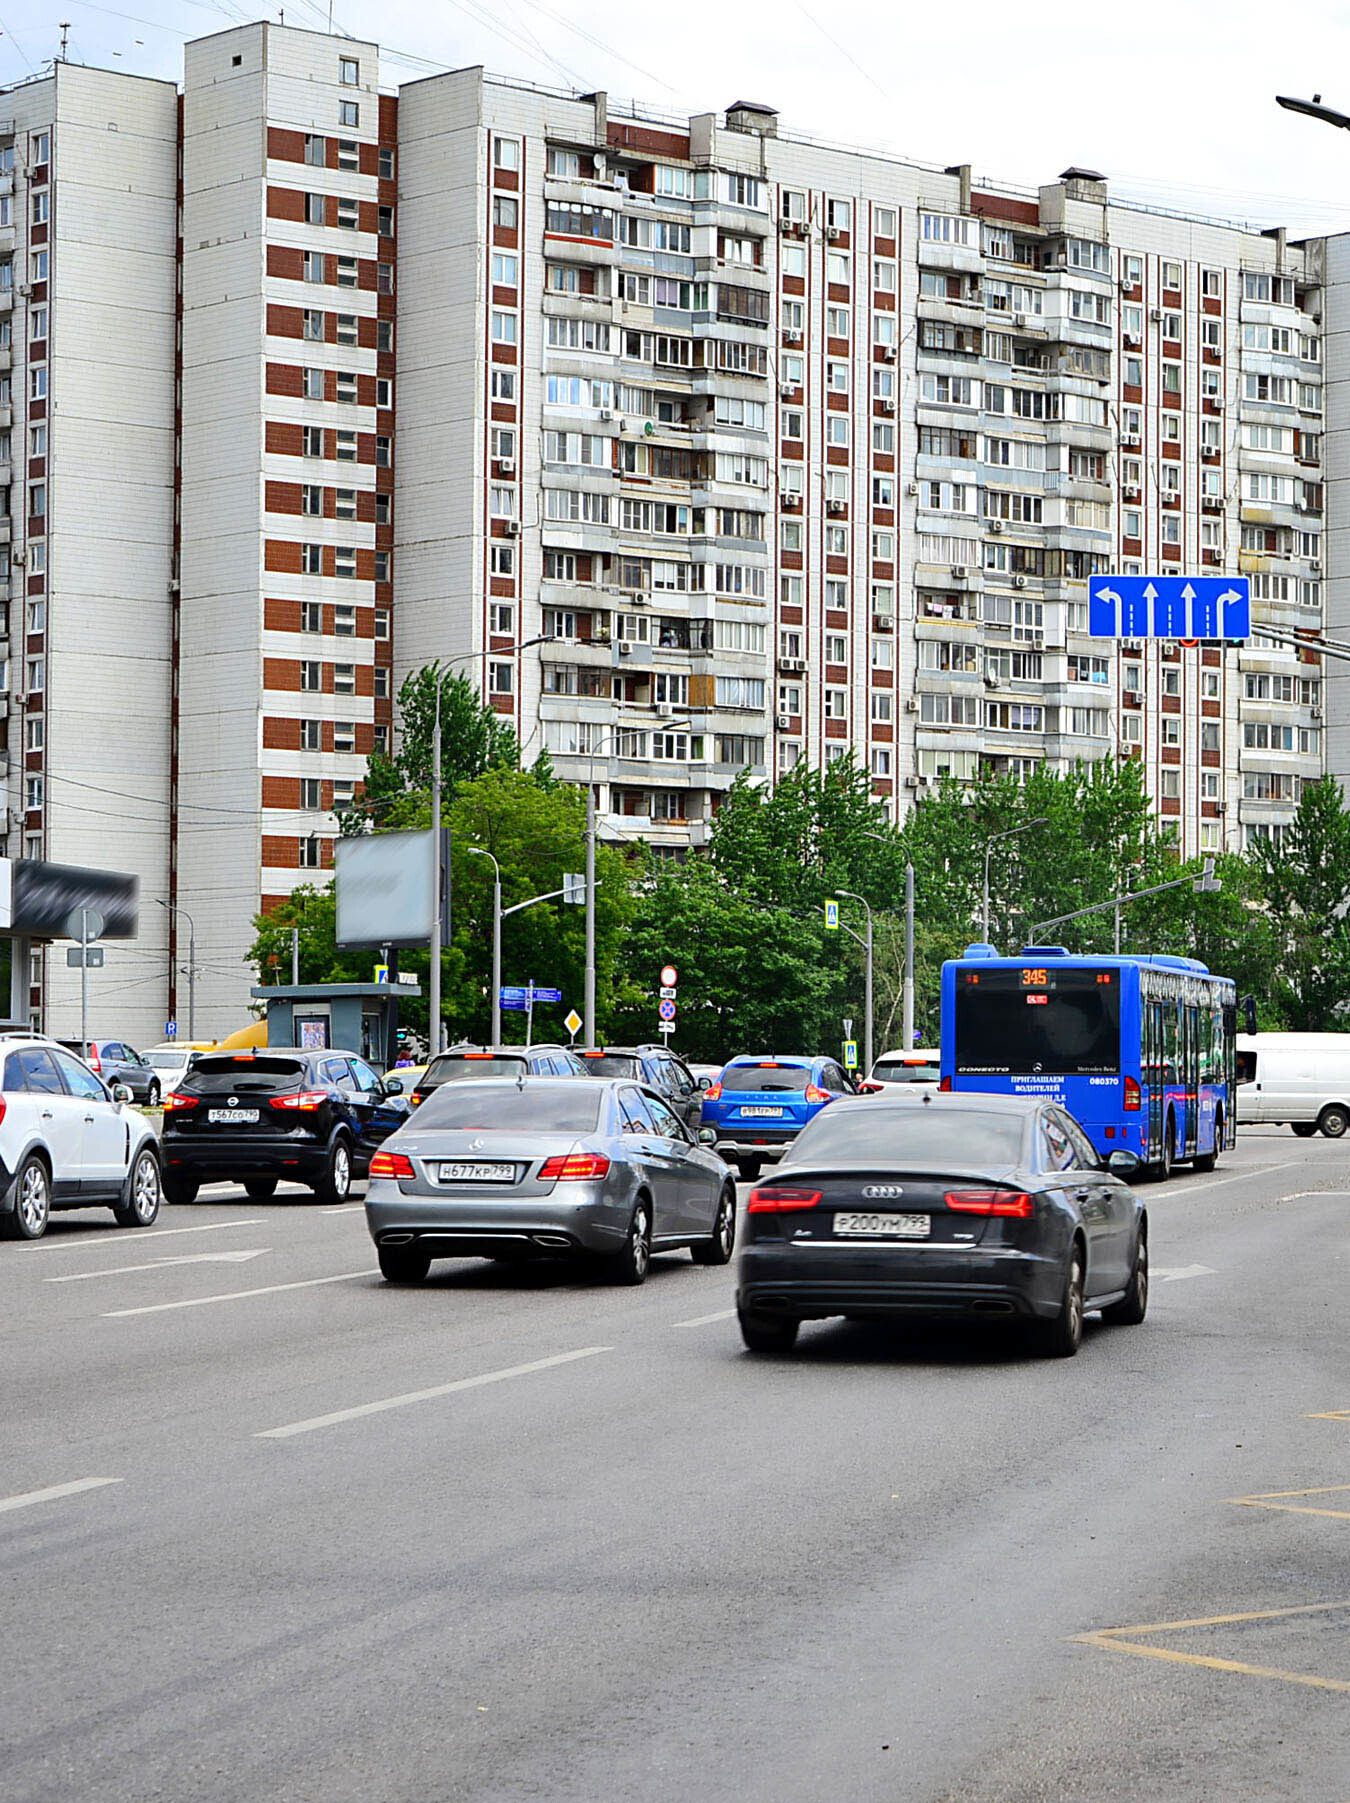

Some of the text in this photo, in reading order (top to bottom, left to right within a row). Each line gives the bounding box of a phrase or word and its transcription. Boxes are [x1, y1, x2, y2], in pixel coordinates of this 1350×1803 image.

[1021, 968, 1048, 985] 345
[1010, 1076, 1065, 1084] ПРИГЛАШАЕМ
[1089, 1077, 1119, 1086] 080370
[1015, 1084, 1060, 1092] ВОДИТЕЛЕЙ
